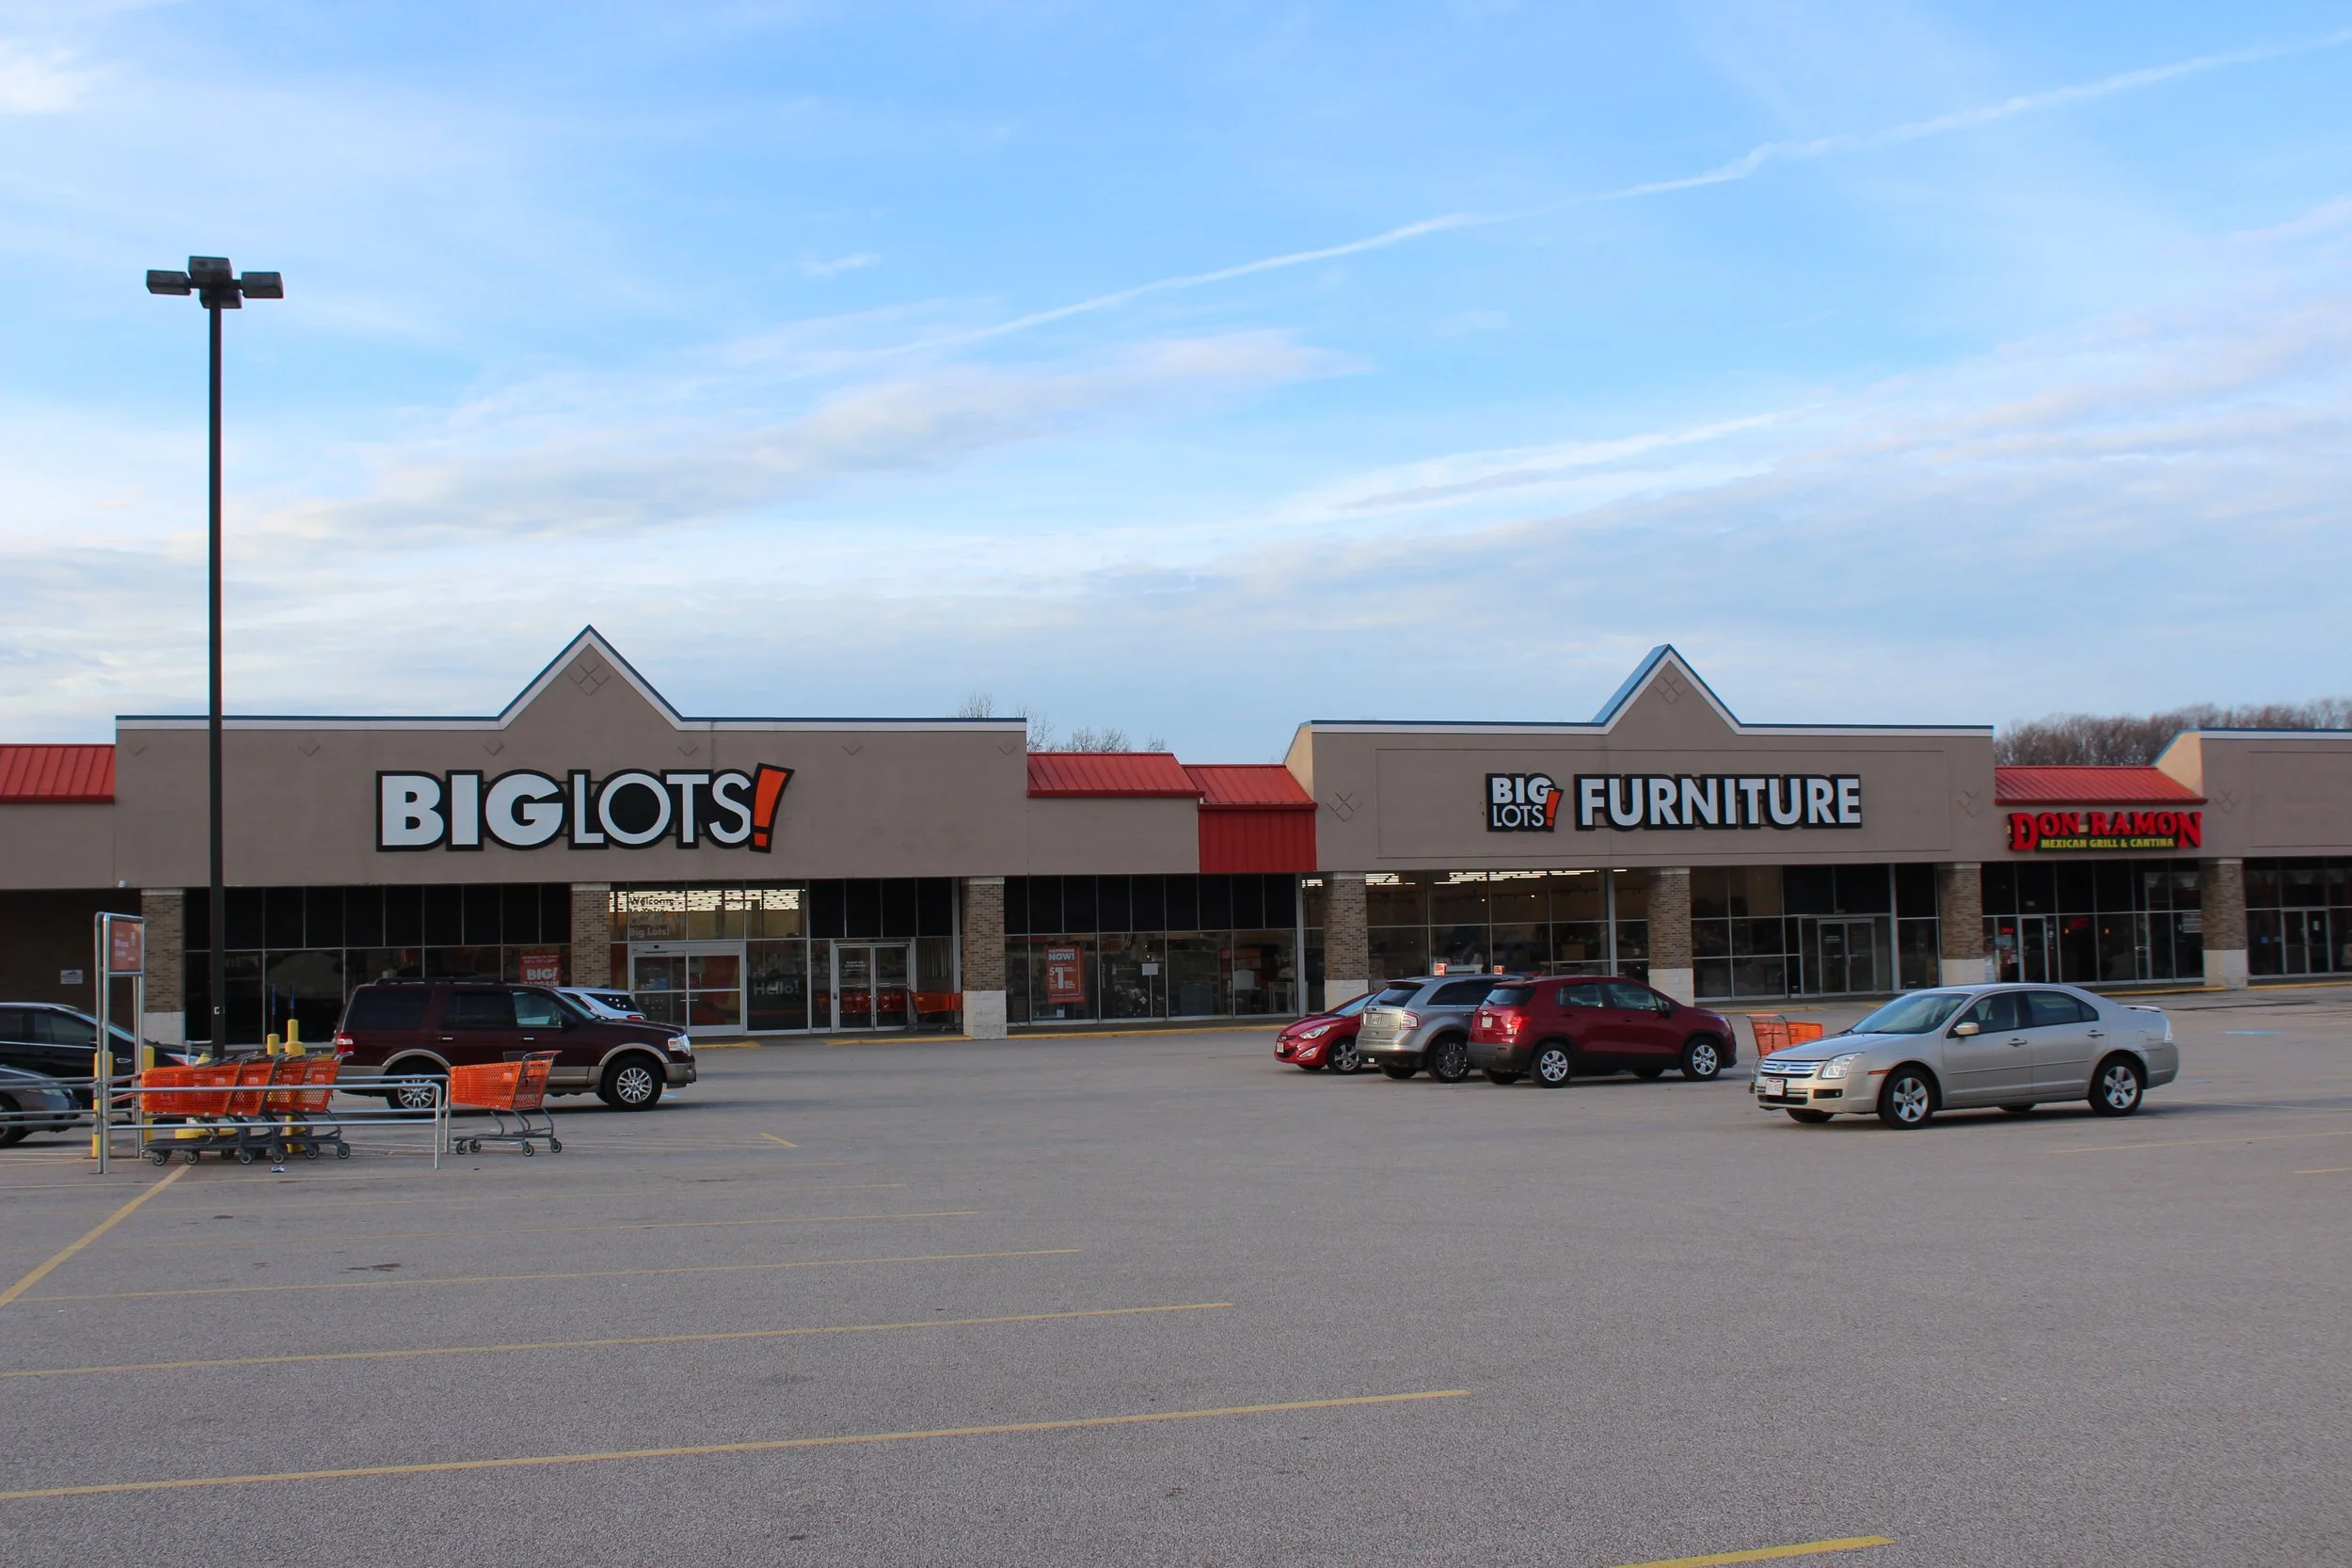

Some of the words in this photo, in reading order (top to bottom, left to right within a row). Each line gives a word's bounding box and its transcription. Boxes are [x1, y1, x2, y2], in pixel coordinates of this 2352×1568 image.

[1492, 776, 1553, 804] BIG
[1581, 777, 1862, 826] FURNITURE
[1492, 792, 1563, 827] LOTS!
[2010, 812, 2080, 850] DON
[2088, 811, 2202, 847] RAMON
[2041, 838, 2088, 848] MEXICAN
[2089, 837, 2119, 848] GRILL
[2121, 838, 2128, 847] &
[2130, 837, 2175, 847] CANTINA
[1048, 952, 1075, 960] NOW!
[753, 978, 801, 996] Hello!
